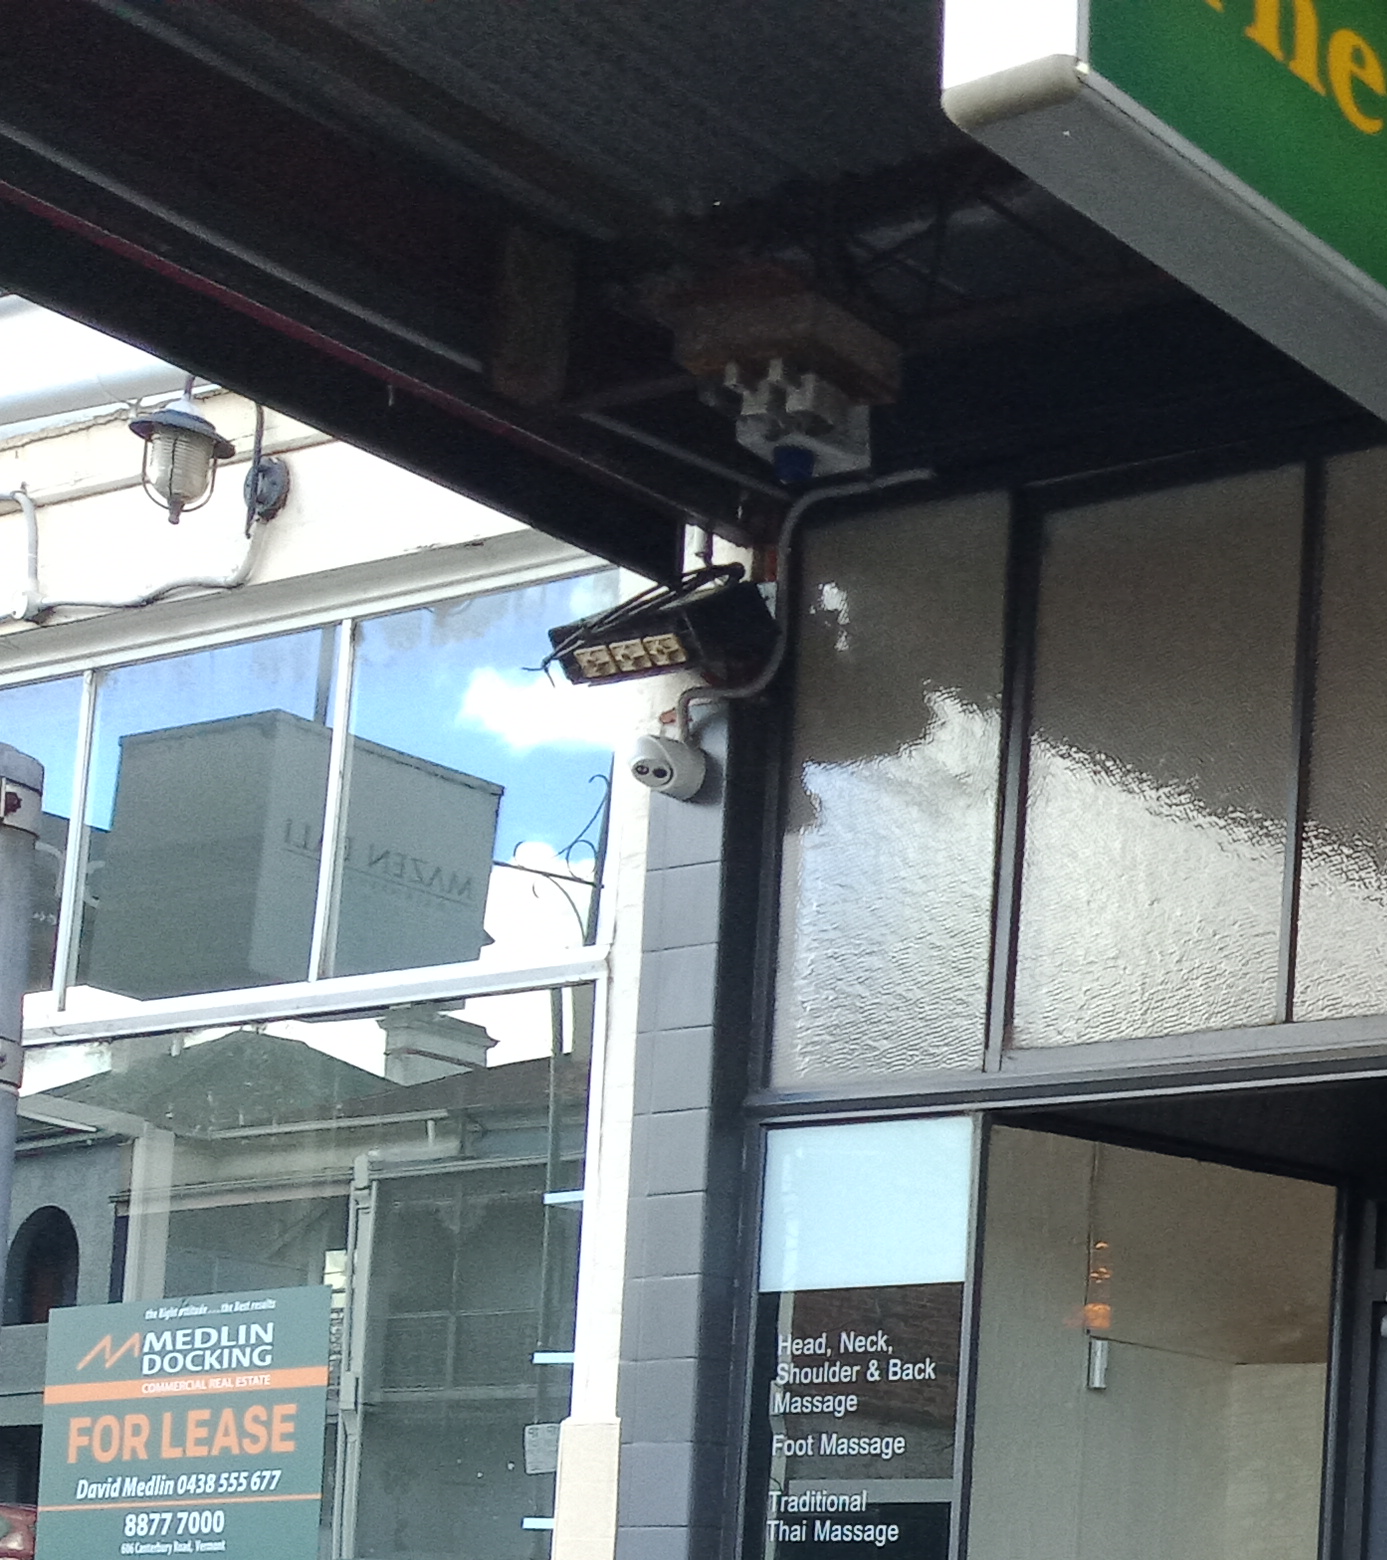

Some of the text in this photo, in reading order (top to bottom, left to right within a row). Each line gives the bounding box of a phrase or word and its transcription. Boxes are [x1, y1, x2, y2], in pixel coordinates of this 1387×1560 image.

[143, 1322, 274, 1352] MEDLIN
[777, 1330, 893, 1357] Head, Neck,
[141, 1345, 273, 1376] DOCKING
[776, 1358, 936, 1384] Shoulder & Back
[141, 1374, 271, 1395] COMMERCIAL REAL ESTATE
[774, 1392, 858, 1417] Massage
[67, 1403, 297, 1464] FOR LEASE
[772, 1433, 906, 1459] Foot Massage
[76, 1469, 282, 1500] David Medlin 0438 555 677
[769, 1490, 867, 1513] Traditional
[124, 1510, 225, 1536] 8877 7000
[767, 1519, 899, 1547] Thai Massage
